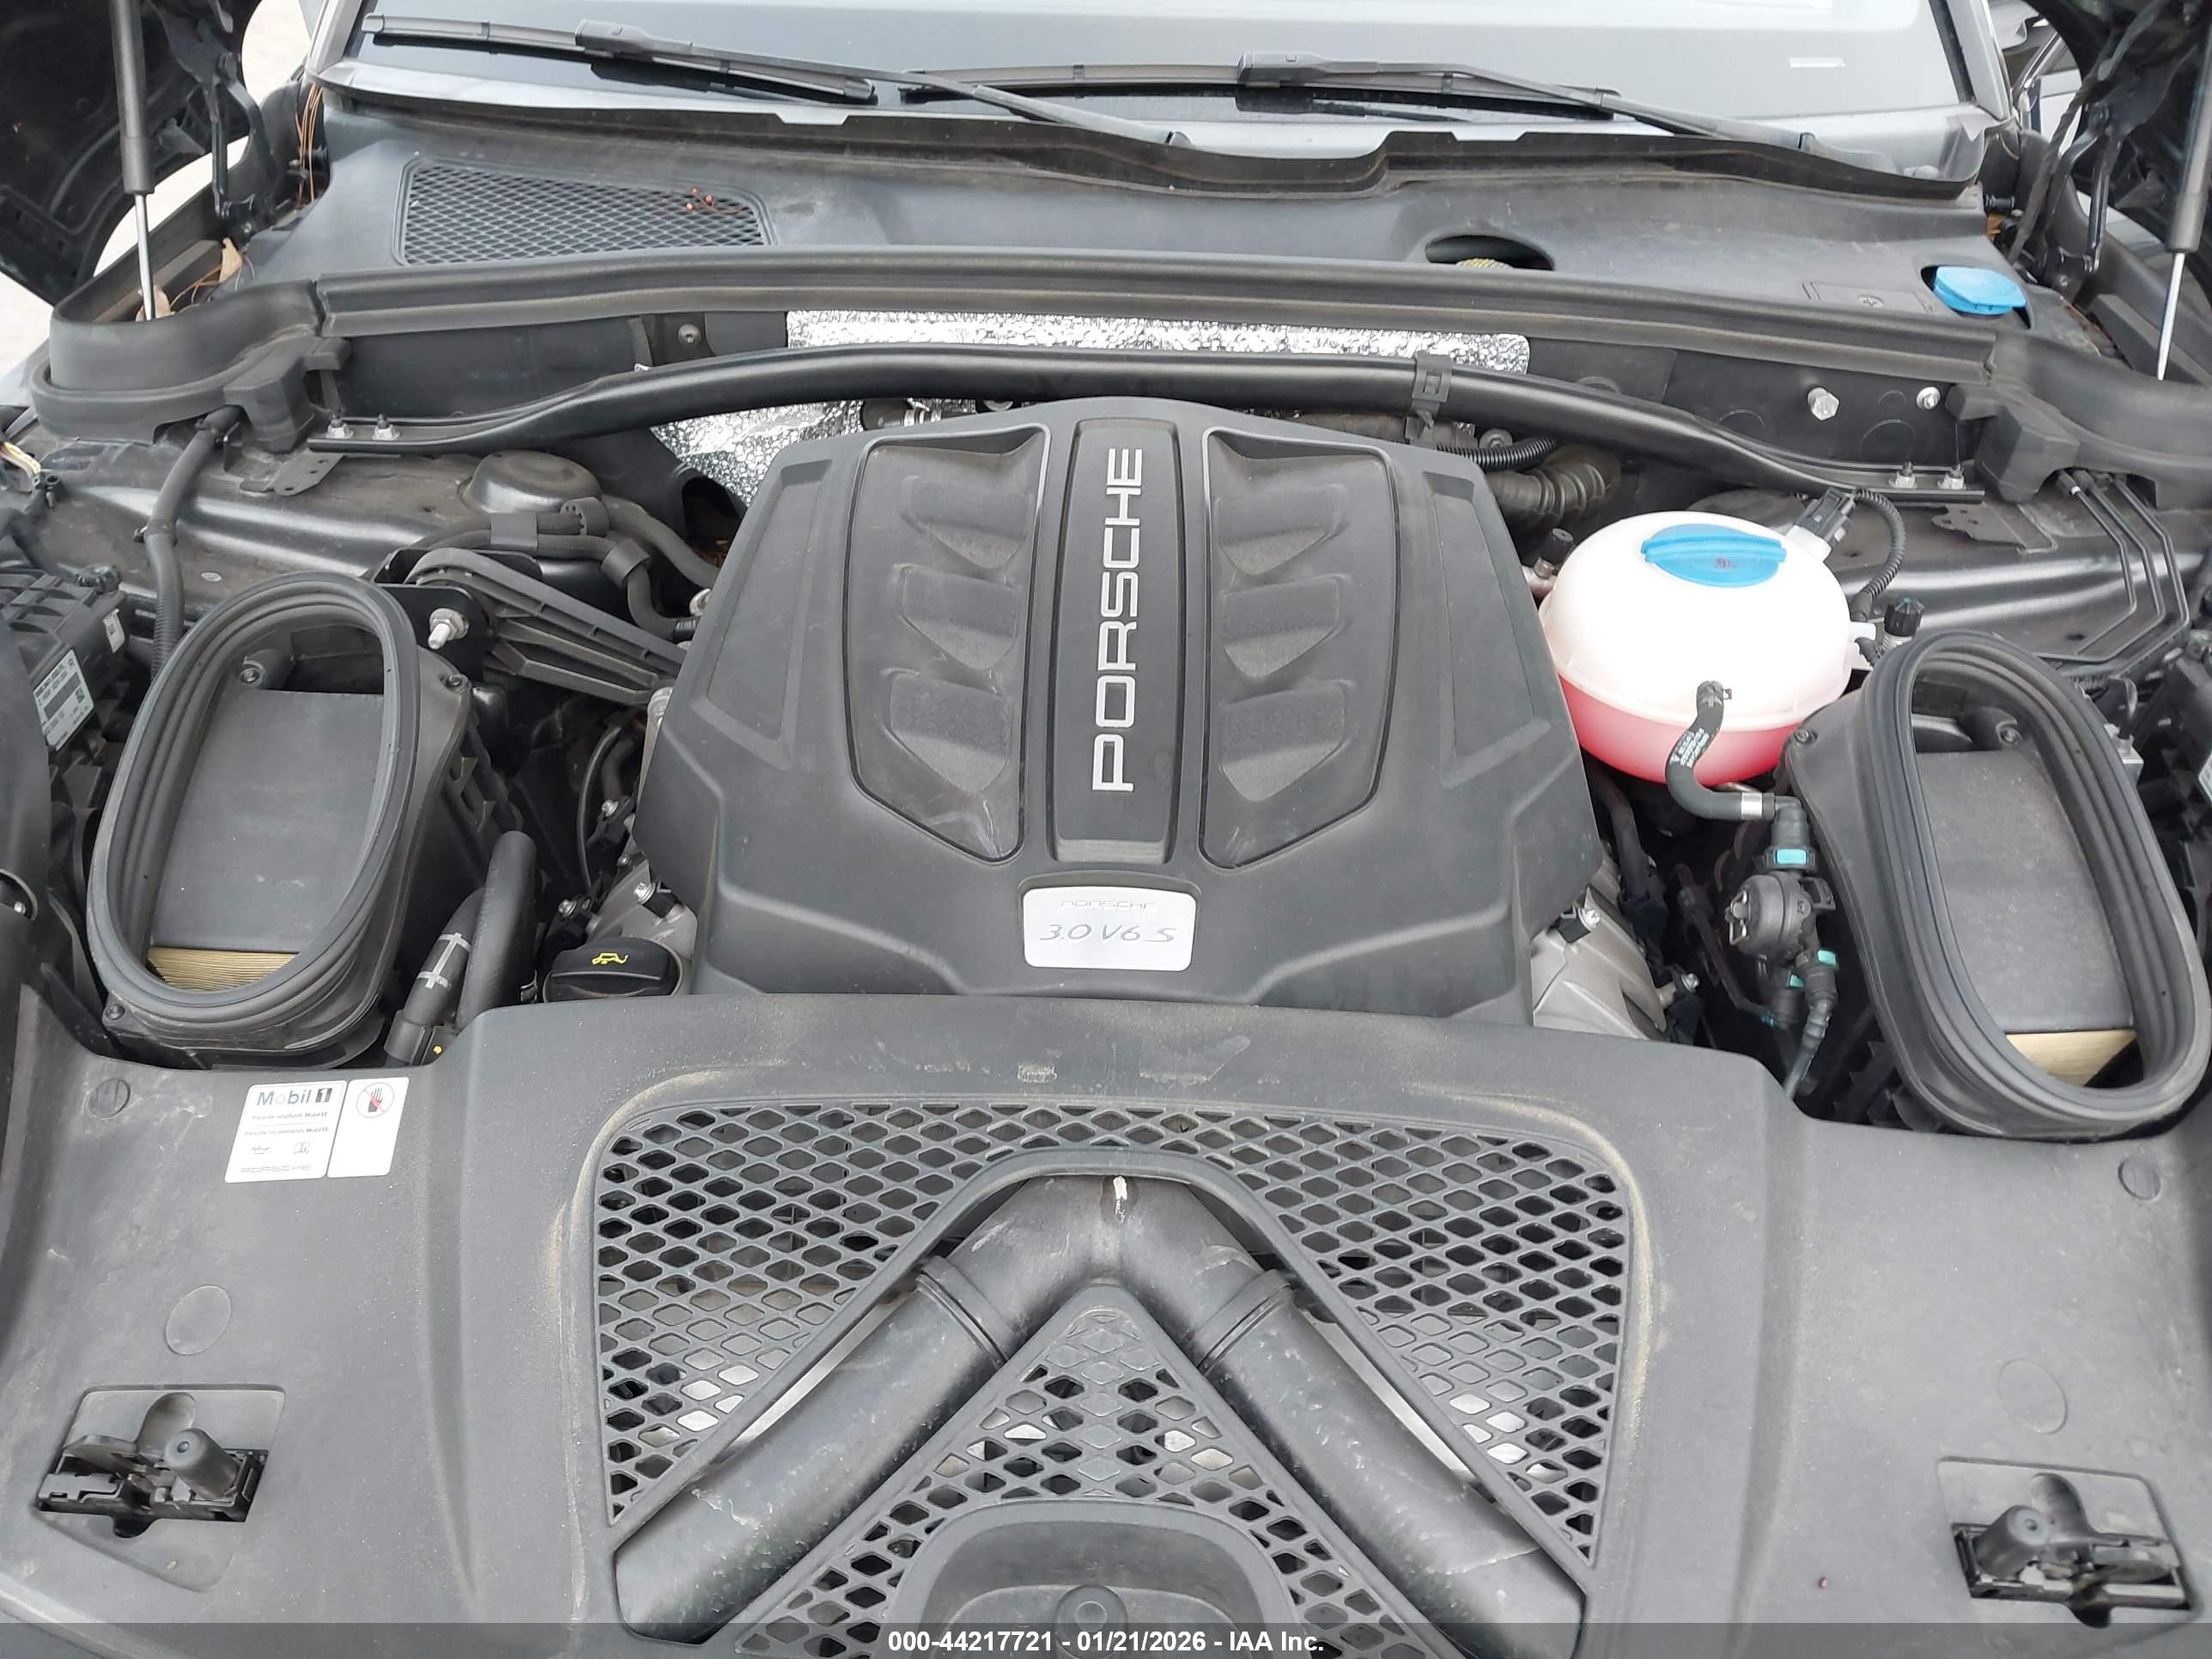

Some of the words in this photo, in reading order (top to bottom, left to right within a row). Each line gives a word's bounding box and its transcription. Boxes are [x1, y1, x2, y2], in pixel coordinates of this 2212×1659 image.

[1092, 447, 1143, 792] PORSCHE
[1039, 923, 1092, 940] 3.0
[1101, 923, 1141, 941] V6
[1144, 927, 1178, 943] S
[257, 1089, 313, 1106] Mobil
